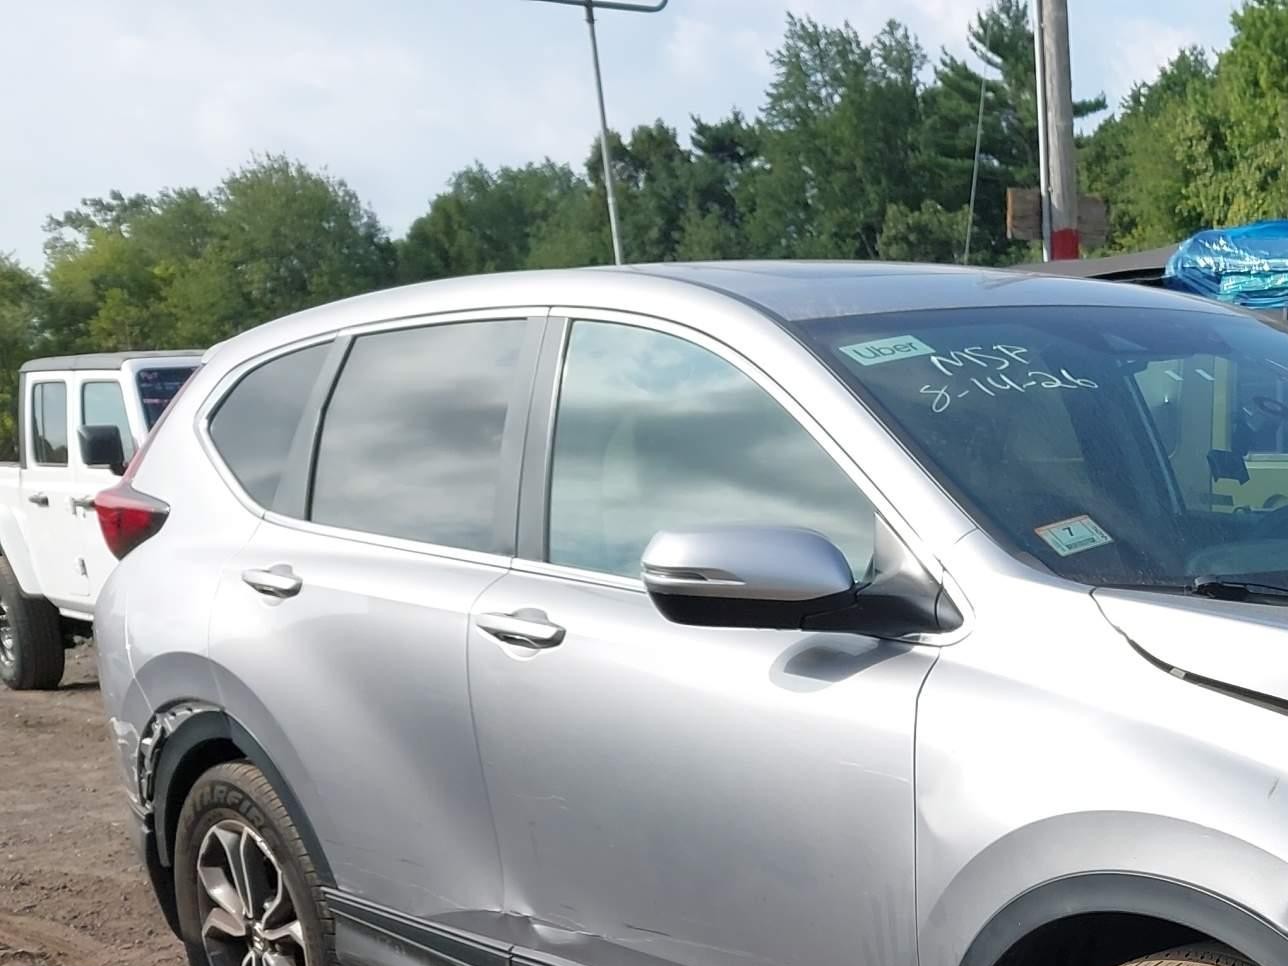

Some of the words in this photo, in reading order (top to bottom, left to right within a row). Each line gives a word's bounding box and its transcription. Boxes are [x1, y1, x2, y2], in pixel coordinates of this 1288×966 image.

[852, 341, 916, 360] Uber
[920, 369, 1099, 412] 8-14-26
[1062, 526, 1075, 537] 7
